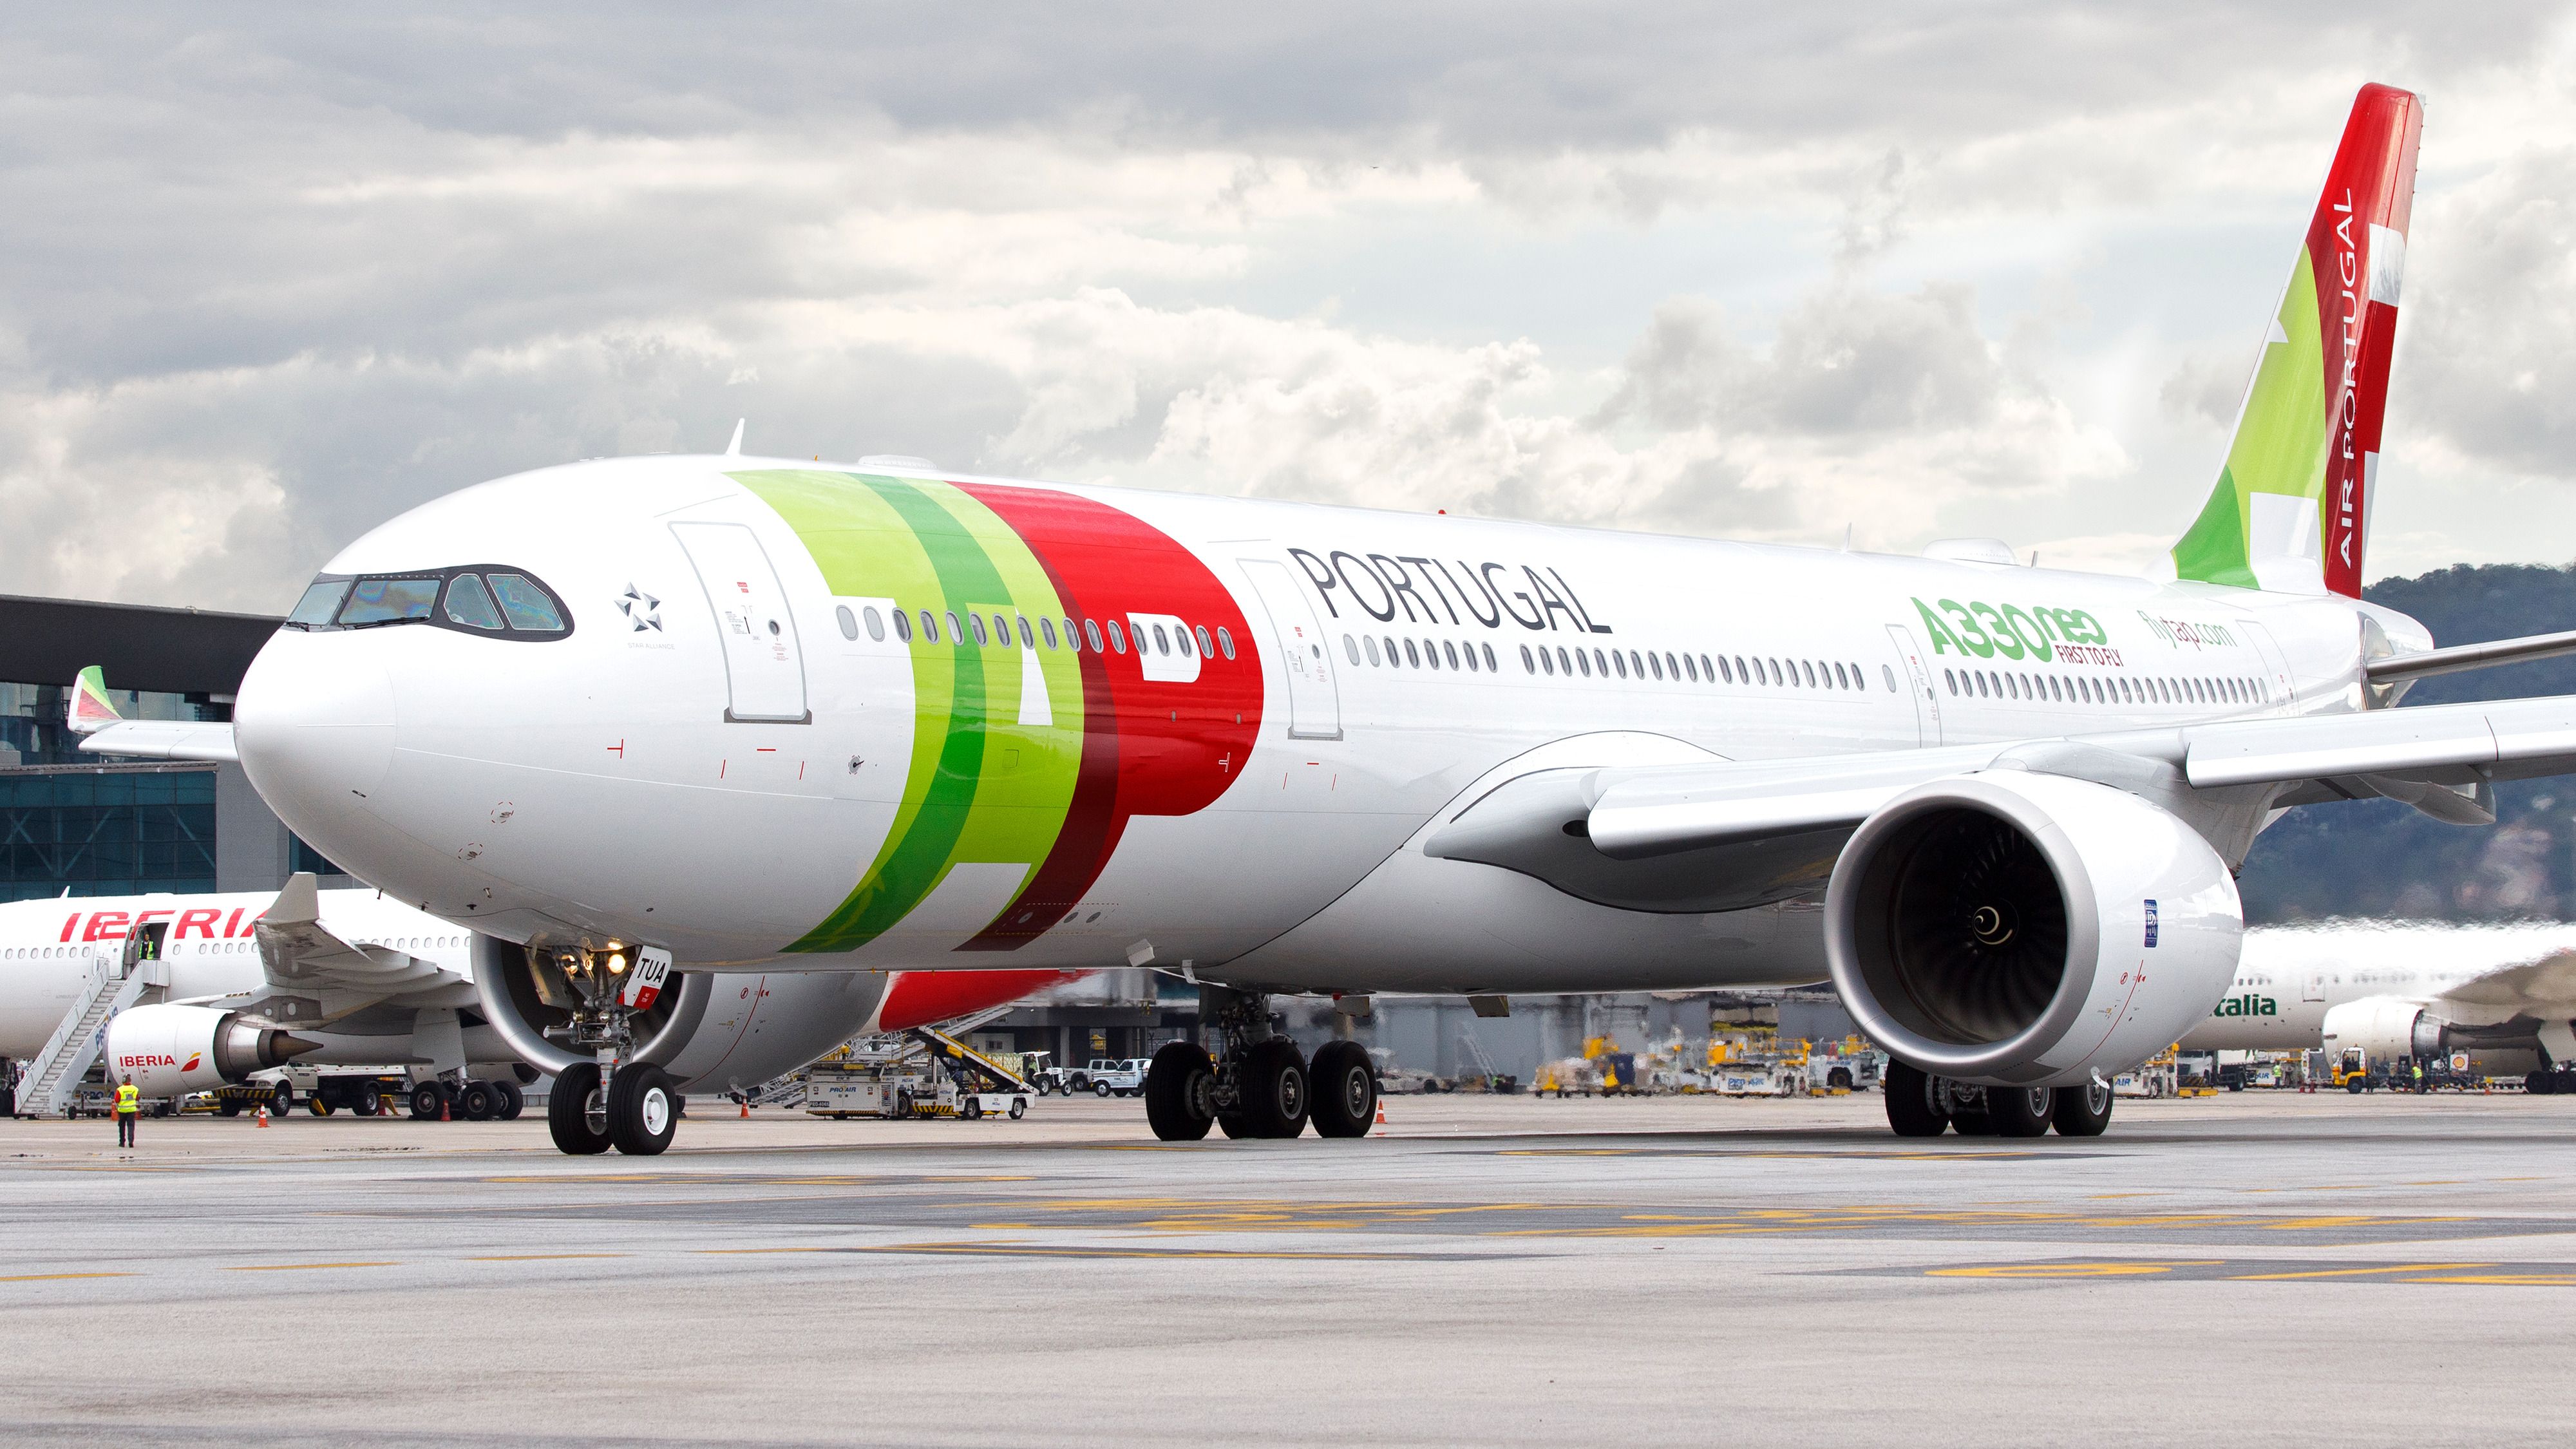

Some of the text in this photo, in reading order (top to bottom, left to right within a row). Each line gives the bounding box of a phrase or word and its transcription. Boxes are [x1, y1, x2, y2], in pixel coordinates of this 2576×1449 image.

[2333, 187, 2357, 569] AIR PORTUGAL
[1287, 547, 1613, 634] PORTUGAL
[2137, 610, 2238, 651] flytap.com
[2054, 645, 2124, 667] FIRST TO FLY
[726, 471, 1264, 952] TAP
[637, 958, 666, 983] TUA
[2210, 994, 2277, 1017] talia
[119, 1055, 176, 1067] IBERIA
